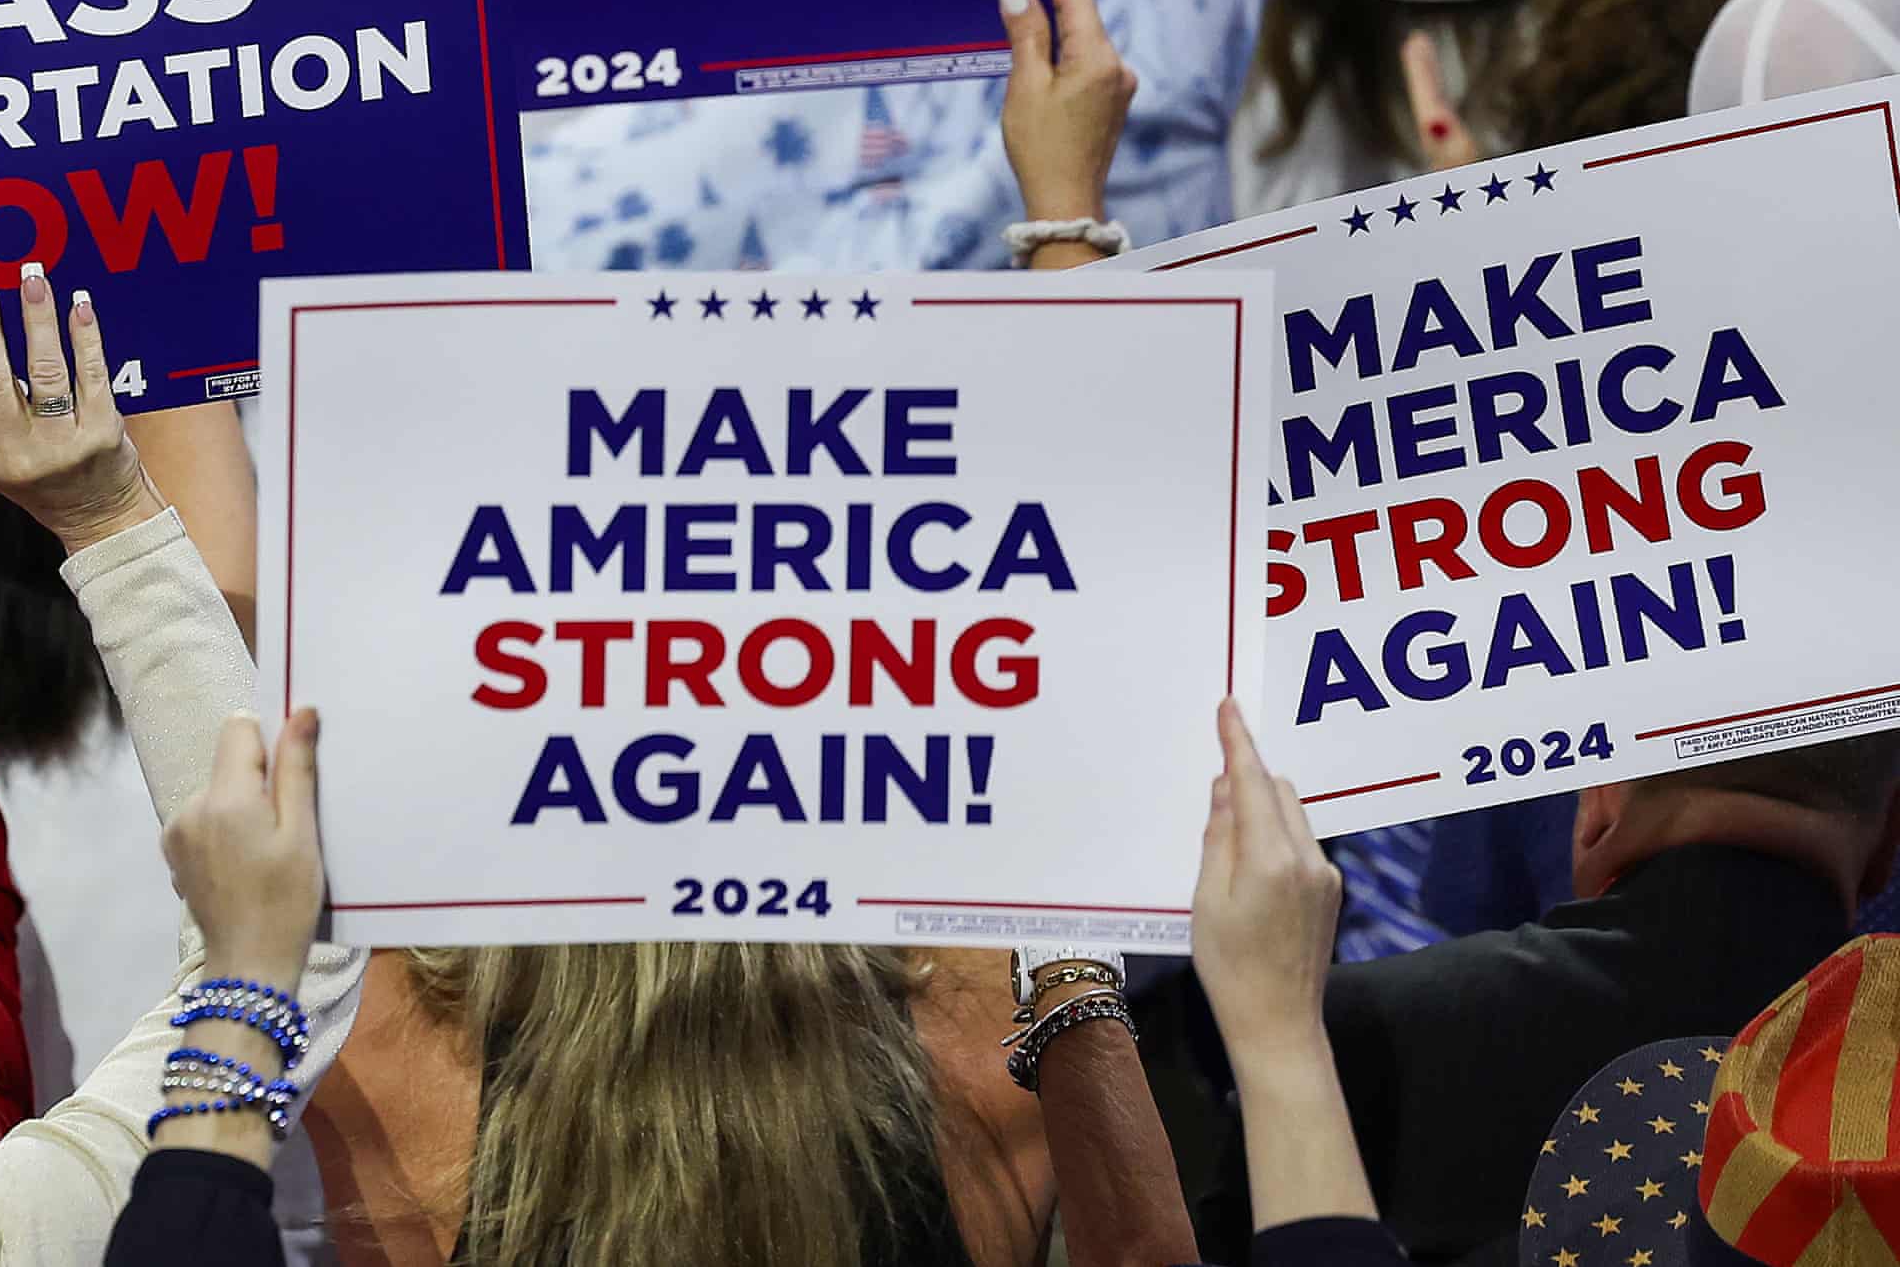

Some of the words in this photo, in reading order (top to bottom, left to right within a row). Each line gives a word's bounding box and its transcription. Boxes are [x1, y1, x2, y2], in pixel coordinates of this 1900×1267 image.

[536, 49, 682, 98] 2024
[1283, 237, 1653, 393] MAKE
[567, 388, 960, 477] MAKE
[1267, 327, 1786, 506] MERICA
[441, 501, 1077, 594] AMERICA
[471, 617, 1040, 710] STRONG
[1295, 555, 1746, 726] AGAIN!
[510, 734, 995, 827] AGAIN!
[1462, 723, 1615, 785] 2024
[672, 879, 833, 918] 2024
